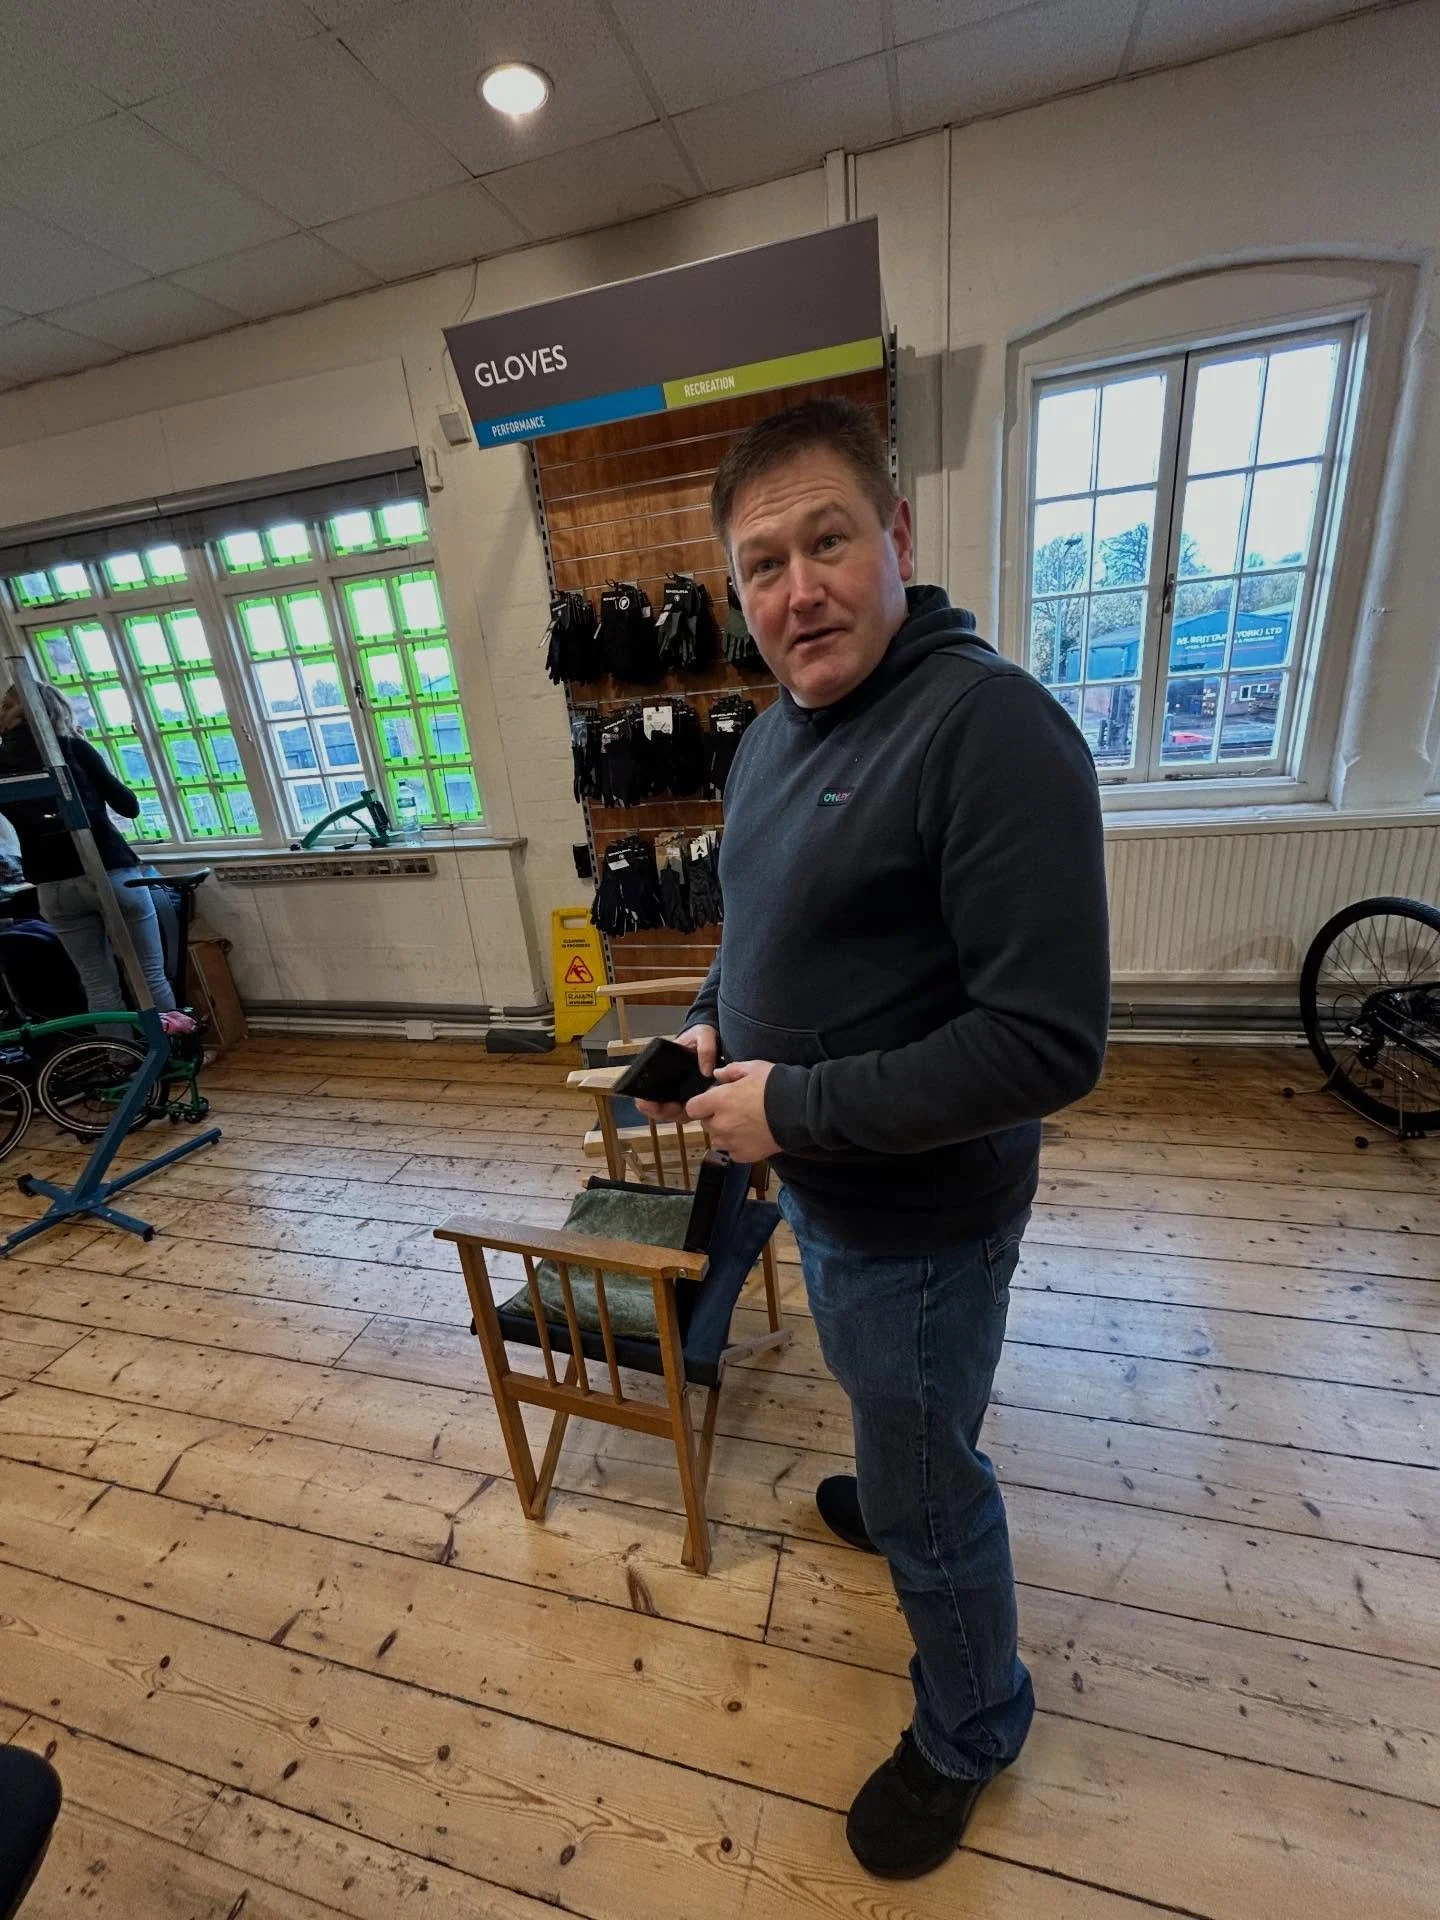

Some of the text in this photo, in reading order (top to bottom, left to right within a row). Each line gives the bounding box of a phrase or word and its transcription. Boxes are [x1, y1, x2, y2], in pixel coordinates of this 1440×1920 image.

[474, 344, 568, 388] GLOVES
[684, 375, 736, 398] RECREATION
[491, 415, 546, 438] PERFORMANCE
[1236, 628, 1264, 639] YORK)
